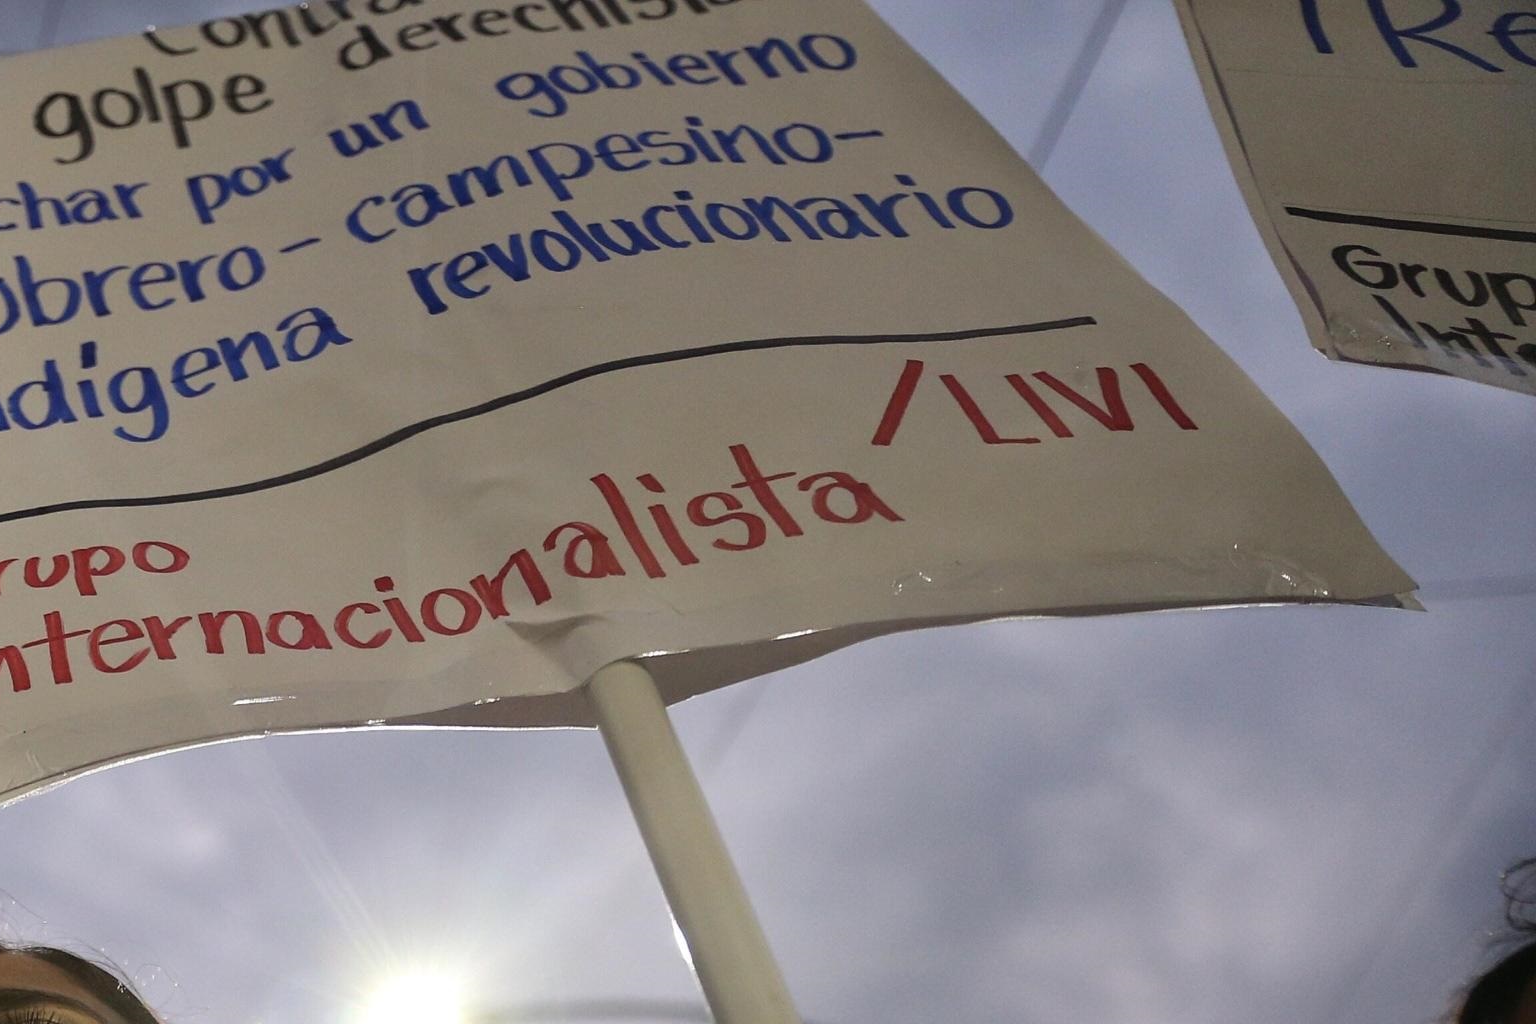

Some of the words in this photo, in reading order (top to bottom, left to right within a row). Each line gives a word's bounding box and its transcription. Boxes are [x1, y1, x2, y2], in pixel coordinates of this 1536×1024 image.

[33, 67, 273, 164] golpe
[186, 148, 295, 224] por
[328, 100, 430, 158] un
[495, 33, 857, 118] gobierno
[407, 175, 1014, 315] revolucionario
[1331, 245, 1536, 327] Grup
